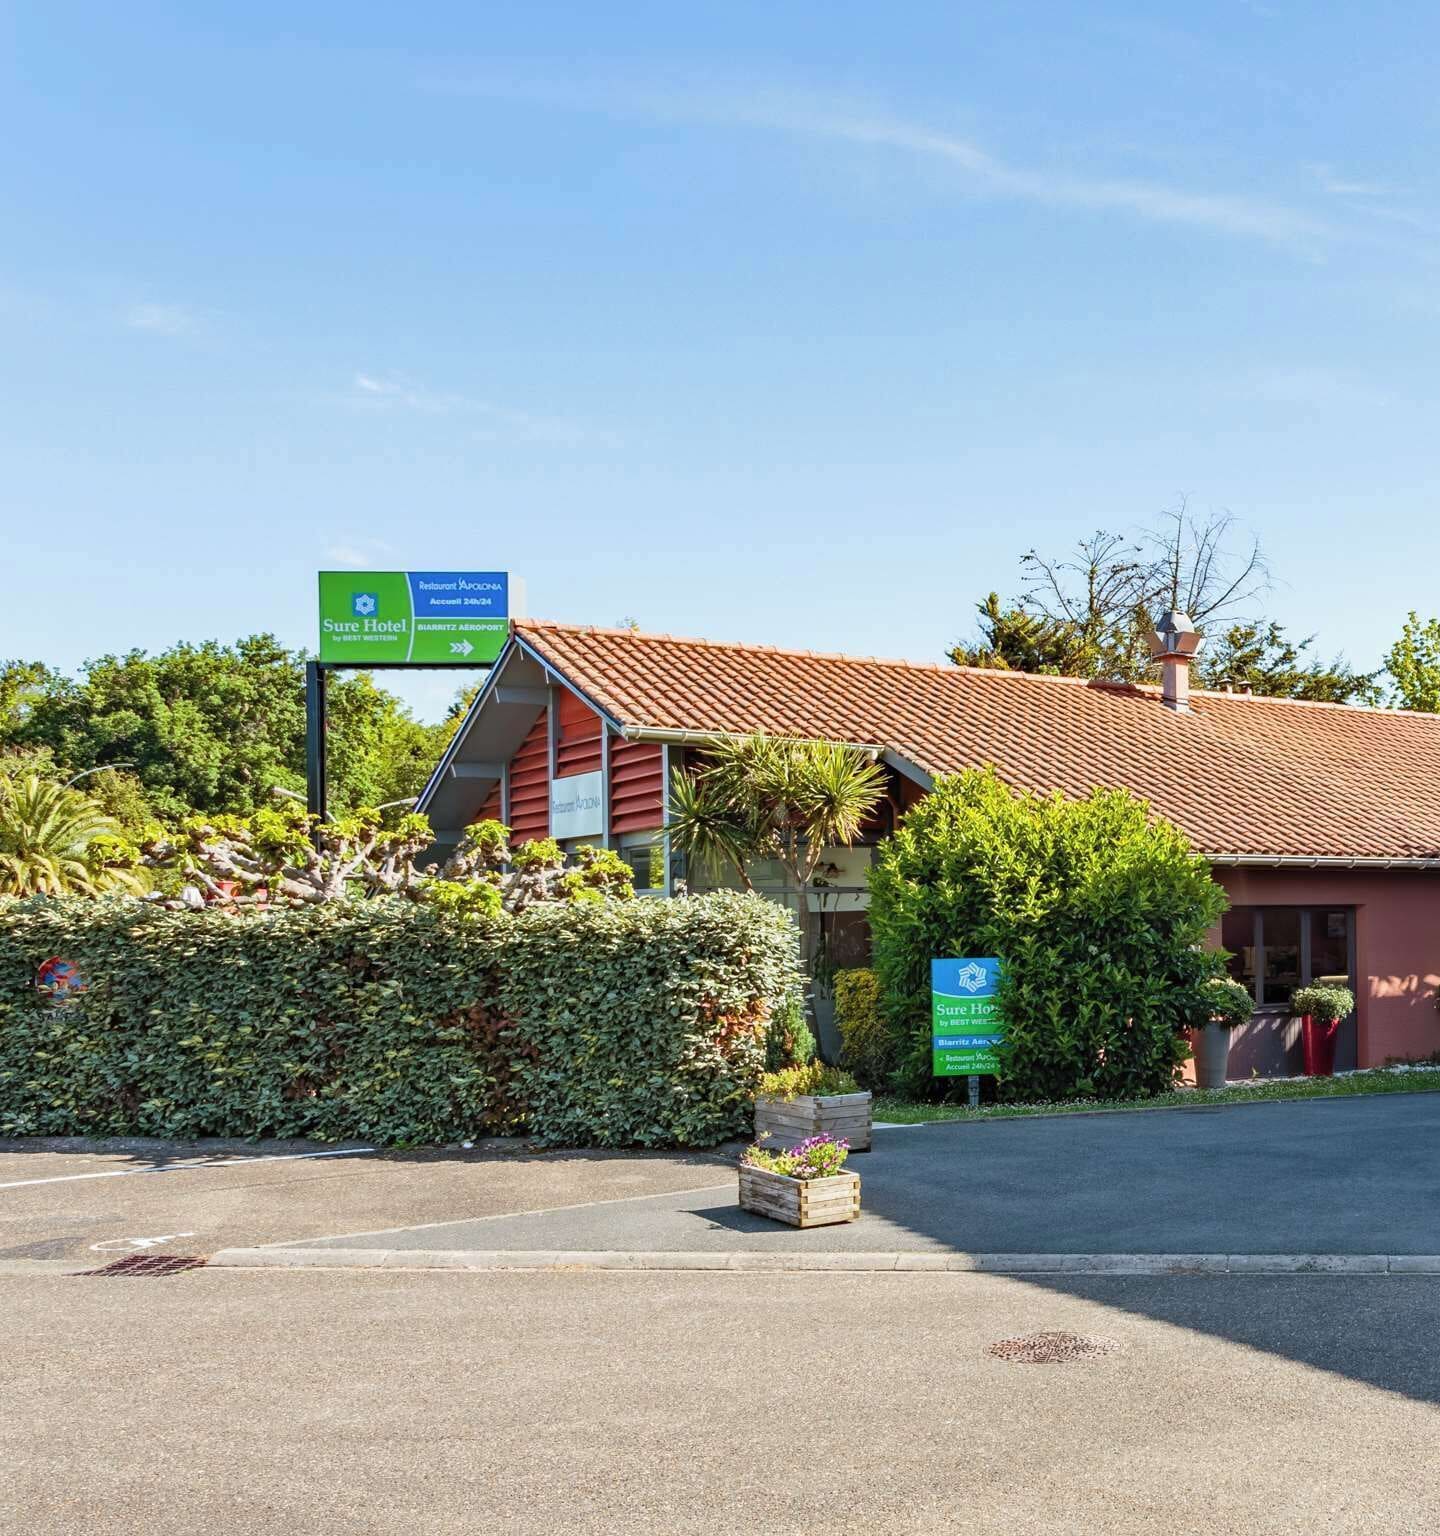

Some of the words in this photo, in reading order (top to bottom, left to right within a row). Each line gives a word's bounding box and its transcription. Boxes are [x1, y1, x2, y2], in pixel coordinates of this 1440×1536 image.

[419, 581, 457, 591] Restaurant
[323, 618, 360, 632] Sure
[363, 618, 407, 632] Hotel
[936, 1003, 967, 1016] Sure
[939, 1019, 948, 1027] by
[938, 1038, 969, 1046] Biarritz
[945, 1063, 970, 1071] Accueil
